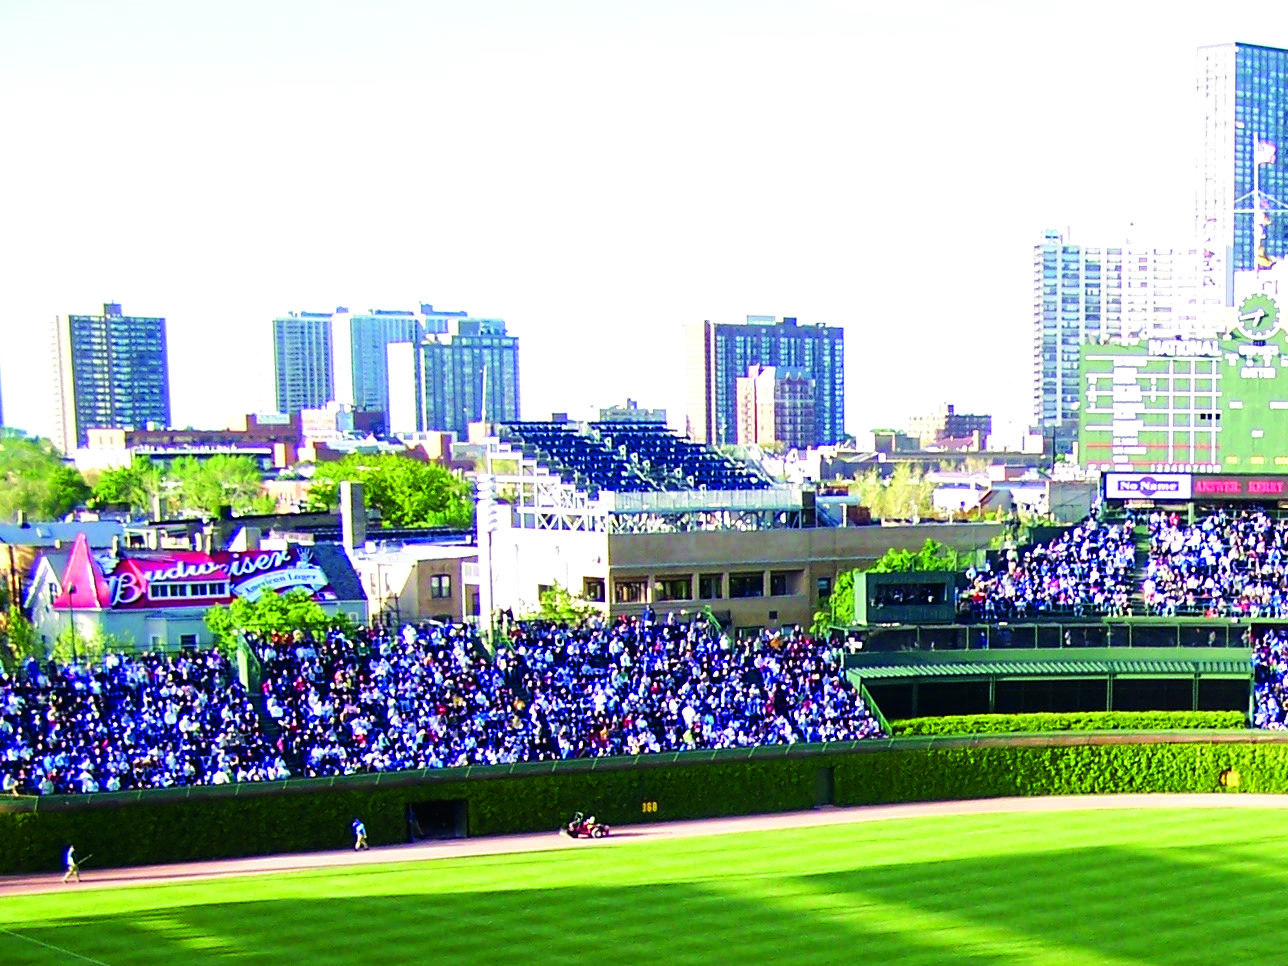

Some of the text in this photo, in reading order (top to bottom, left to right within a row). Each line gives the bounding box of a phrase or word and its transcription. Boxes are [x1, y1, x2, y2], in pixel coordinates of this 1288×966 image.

[1148, 340, 1222, 356] NATIONAL
[1119, 481, 1177, 491] No Name
[1195, 480, 1241, 493] ANSWER:
[1248, 480, 1283, 494] KERRY
